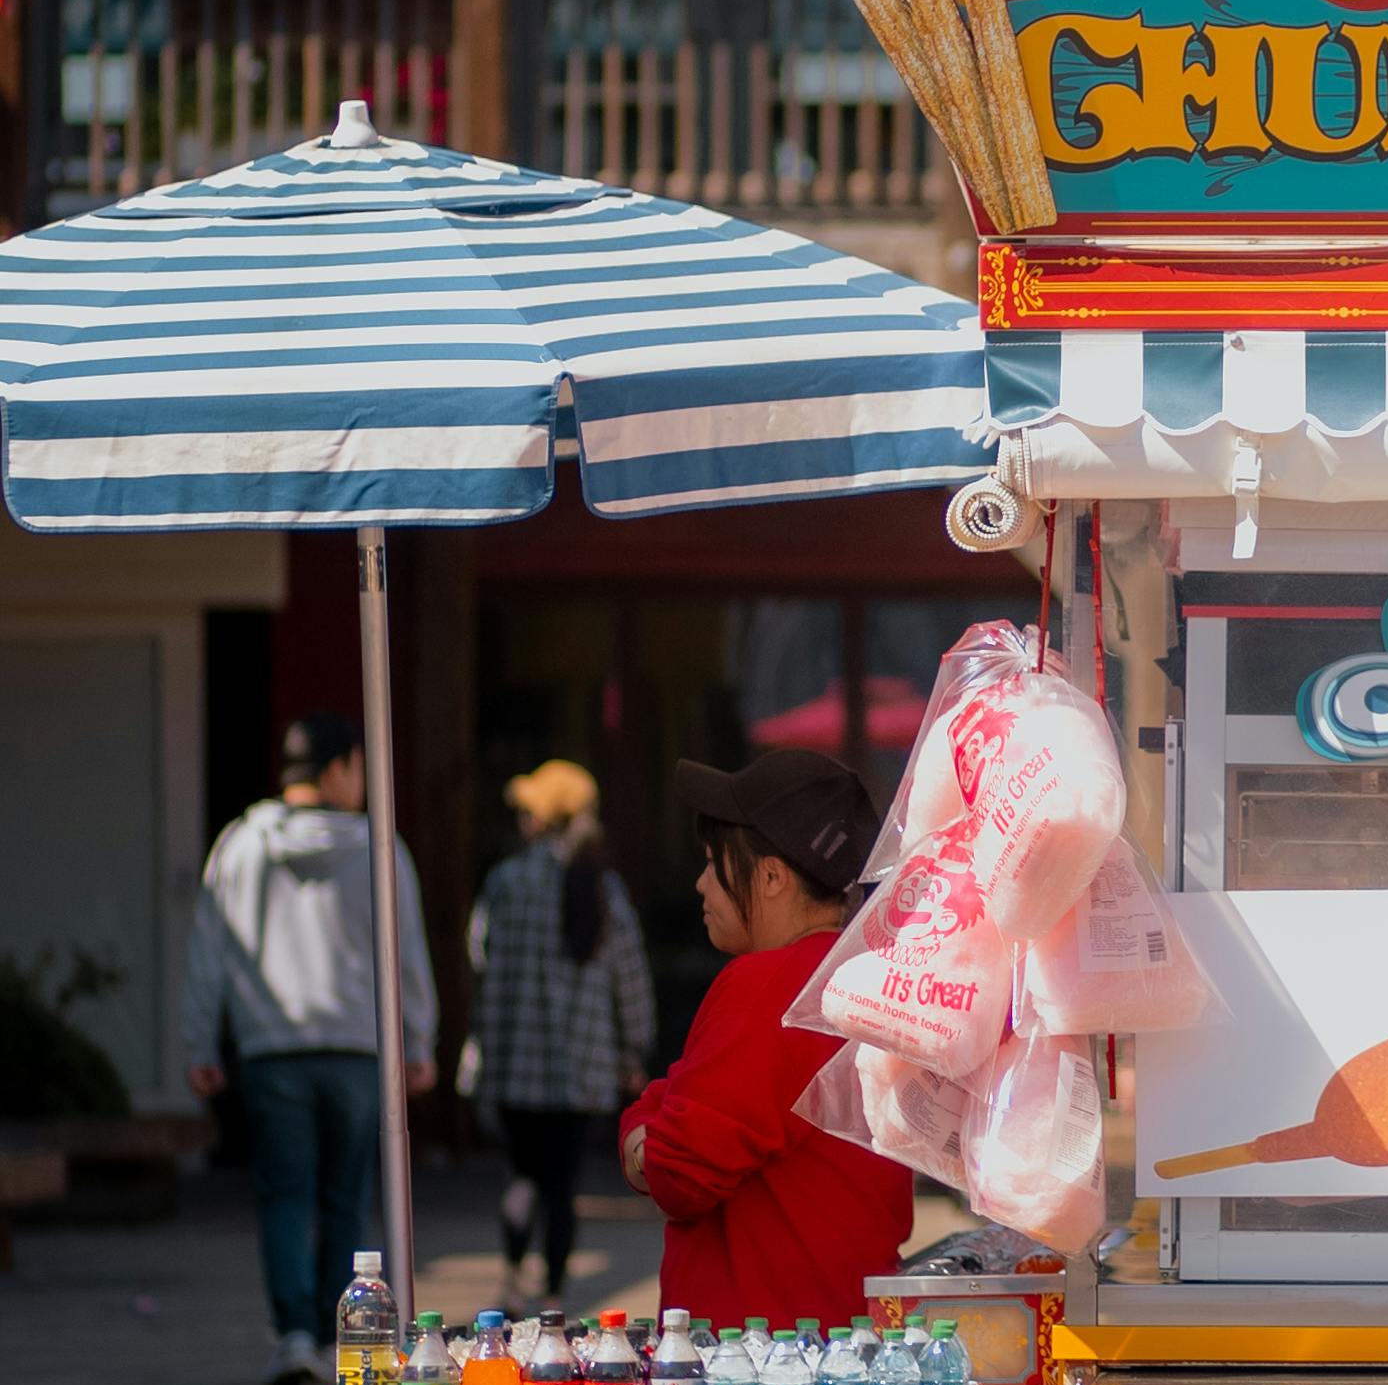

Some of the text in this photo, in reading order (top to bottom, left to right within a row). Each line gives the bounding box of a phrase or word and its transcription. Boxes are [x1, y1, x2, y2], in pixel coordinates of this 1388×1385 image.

[1007, 746, 1053, 800] Great
[994, 841, 1015, 873] some
[1011, 807, 1032, 841] home
[881, 967, 978, 1011] it's Great
[848, 991, 881, 1011] some
[883, 1003, 918, 1024] home
[921, 1017, 961, 1040] today!
